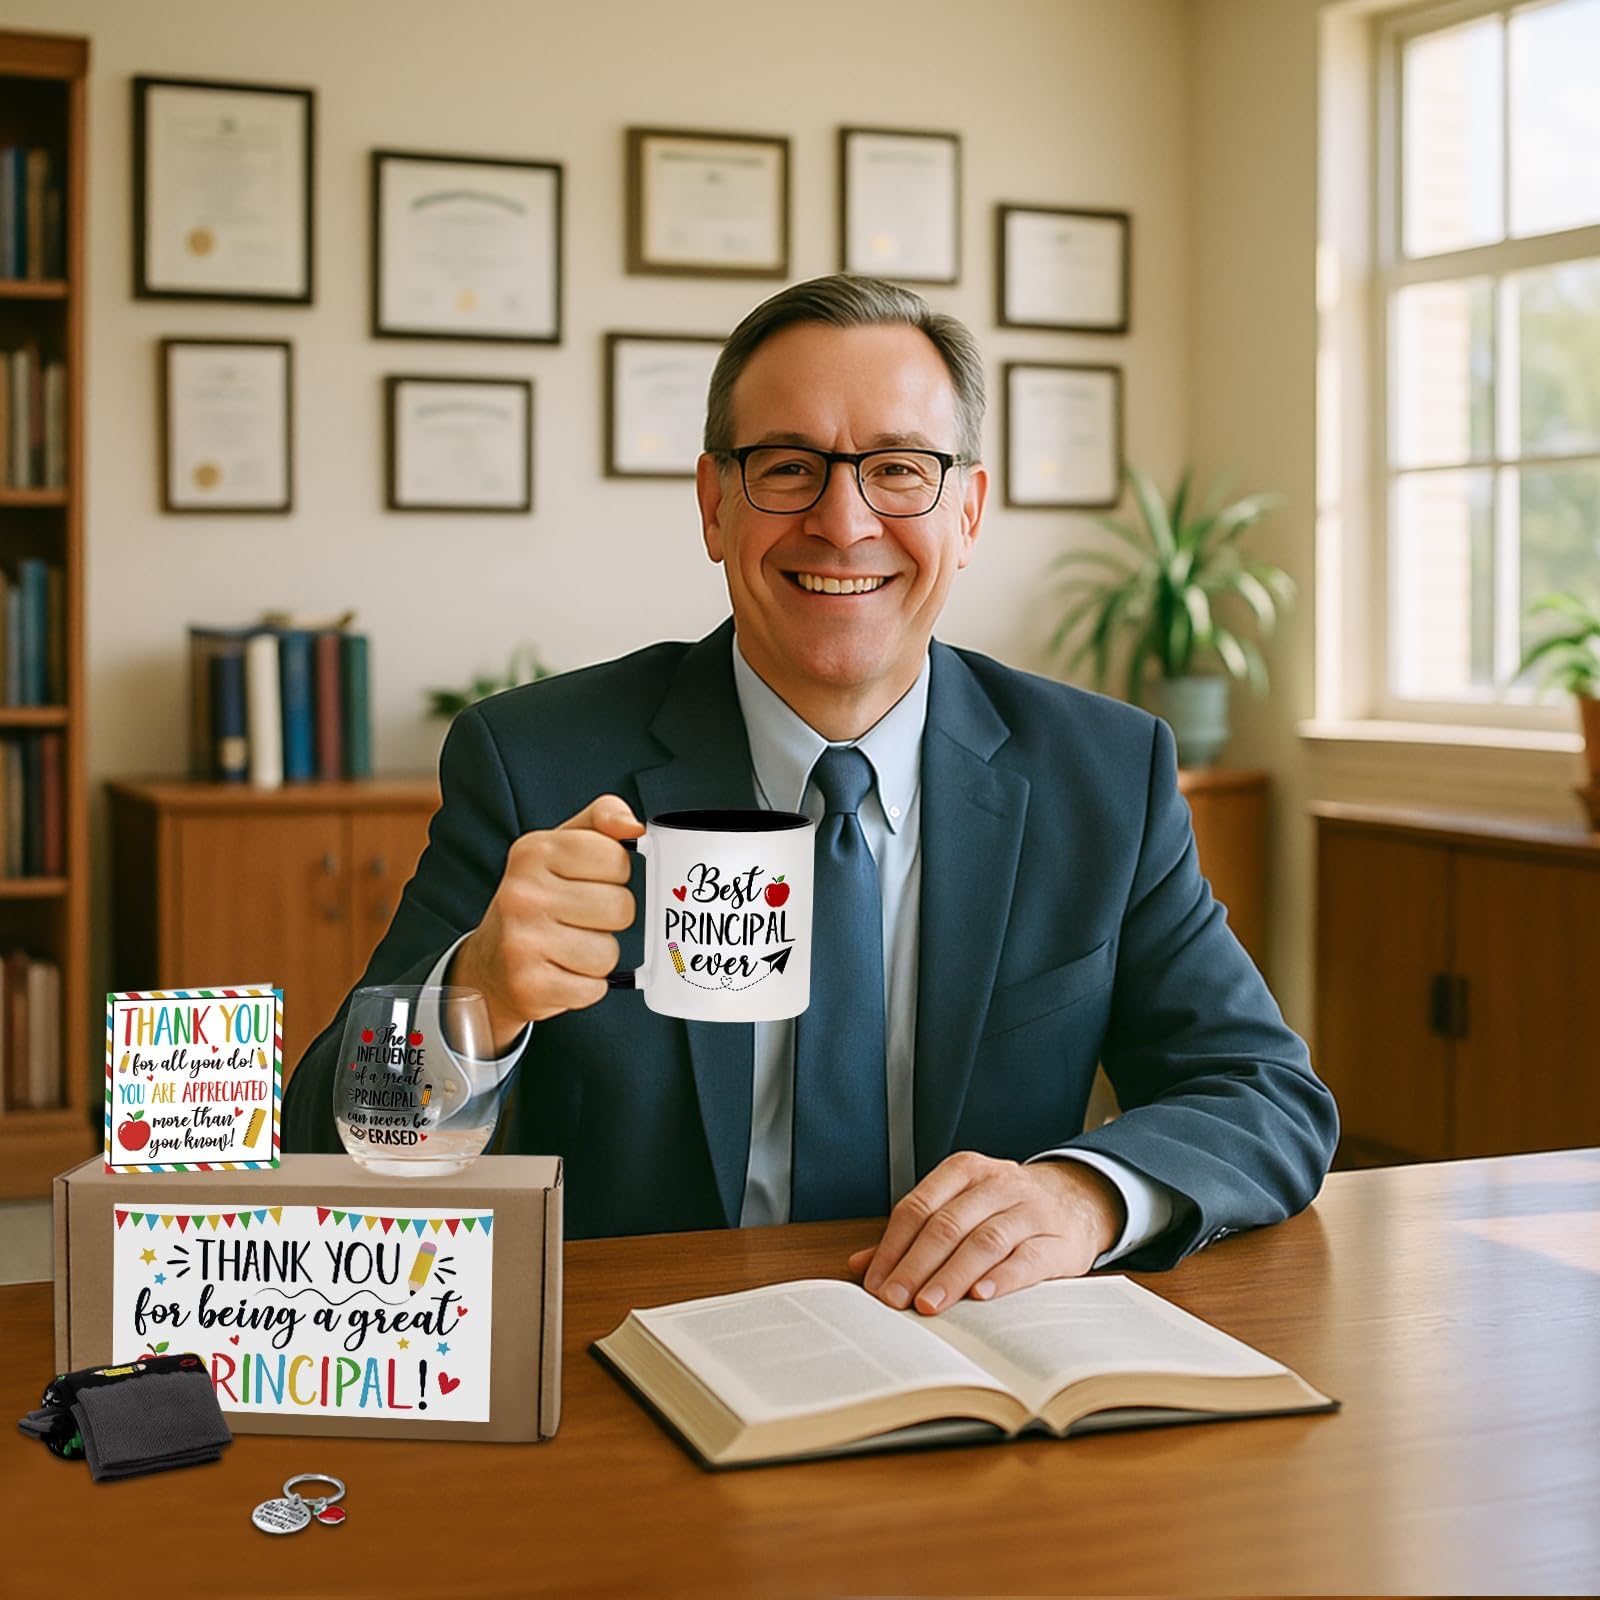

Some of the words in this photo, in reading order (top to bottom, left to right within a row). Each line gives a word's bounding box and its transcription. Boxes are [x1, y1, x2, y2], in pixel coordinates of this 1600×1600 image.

[687, 863, 765, 909] Best
[665, 908, 796, 945] PRINCIPAL
[690, 952, 758, 977] ever
[120, 1005, 211, 1046] THANK
[219, 1003, 269, 1044] YOU
[376, 1023, 406, 1046] The
[132, 1053, 158, 1076] for
[161, 1049, 188, 1071] all
[190, 1056, 225, 1078] you
[227, 1048, 254, 1070] do!
[357, 1046, 425, 1066] INFLUENCE
[355, 1066, 368, 1085] of
[382, 1067, 425, 1088] great
[118, 1083, 145, 1104] YOU
[151, 1082, 176, 1104] ARE
[182, 1080, 267, 1103] APPRECIATED
[355, 1088, 418, 1107] PRINCIPAL
[152, 1114, 191, 1128] more
[191, 1106, 234, 1127] than
[348, 1113, 368, 1124] can
[369, 1114, 410, 1126] never
[413, 1113, 430, 1128] be
[149, 1136, 181, 1158] you
[184, 1128, 235, 1151] know!
[368, 1129, 418, 1146] ERASED
[196, 1238, 313, 1283] THANK
[325, 1241, 401, 1285] YOU
[135, 1287, 190, 1335] for
[198, 1283, 306, 1349] being
[314, 1307, 341, 1332] a
[343, 1290, 463, 1352] great
[183, 1351, 428, 1410] RINCIPAL!
